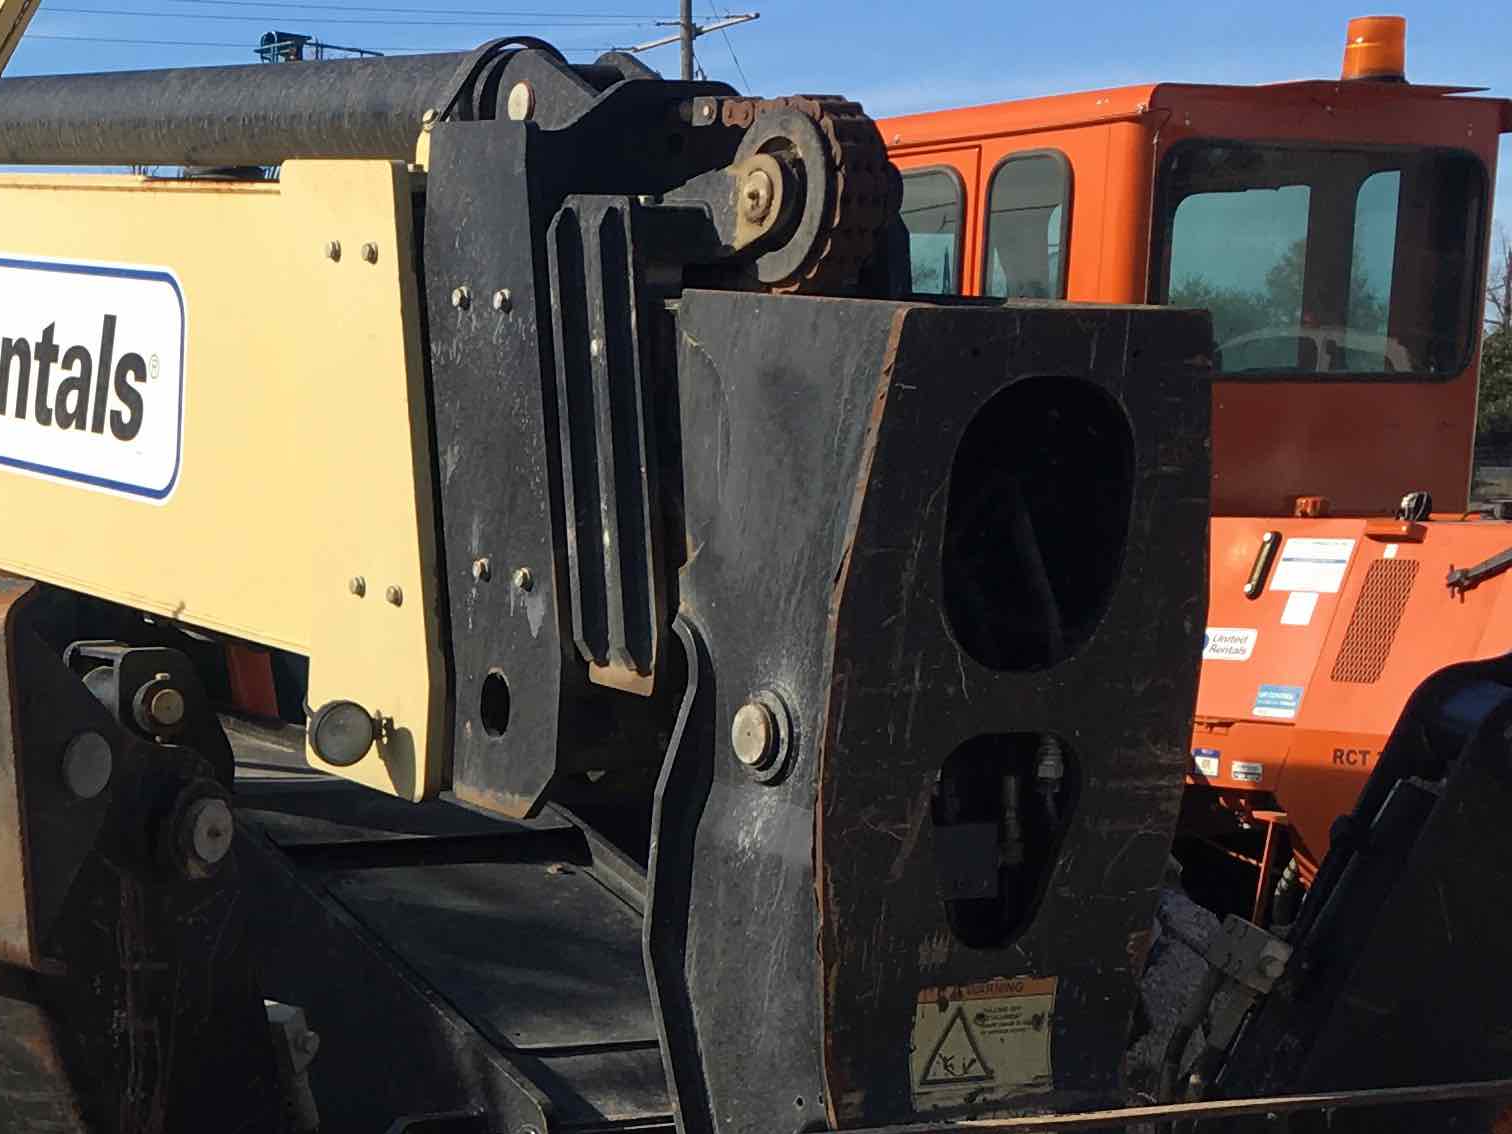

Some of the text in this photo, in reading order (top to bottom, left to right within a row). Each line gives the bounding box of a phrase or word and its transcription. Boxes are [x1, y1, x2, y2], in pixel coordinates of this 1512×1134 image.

[1212, 634, 1249, 645] United
[1208, 643, 1248, 656] Rentals
[1332, 748, 1370, 766] RCT
